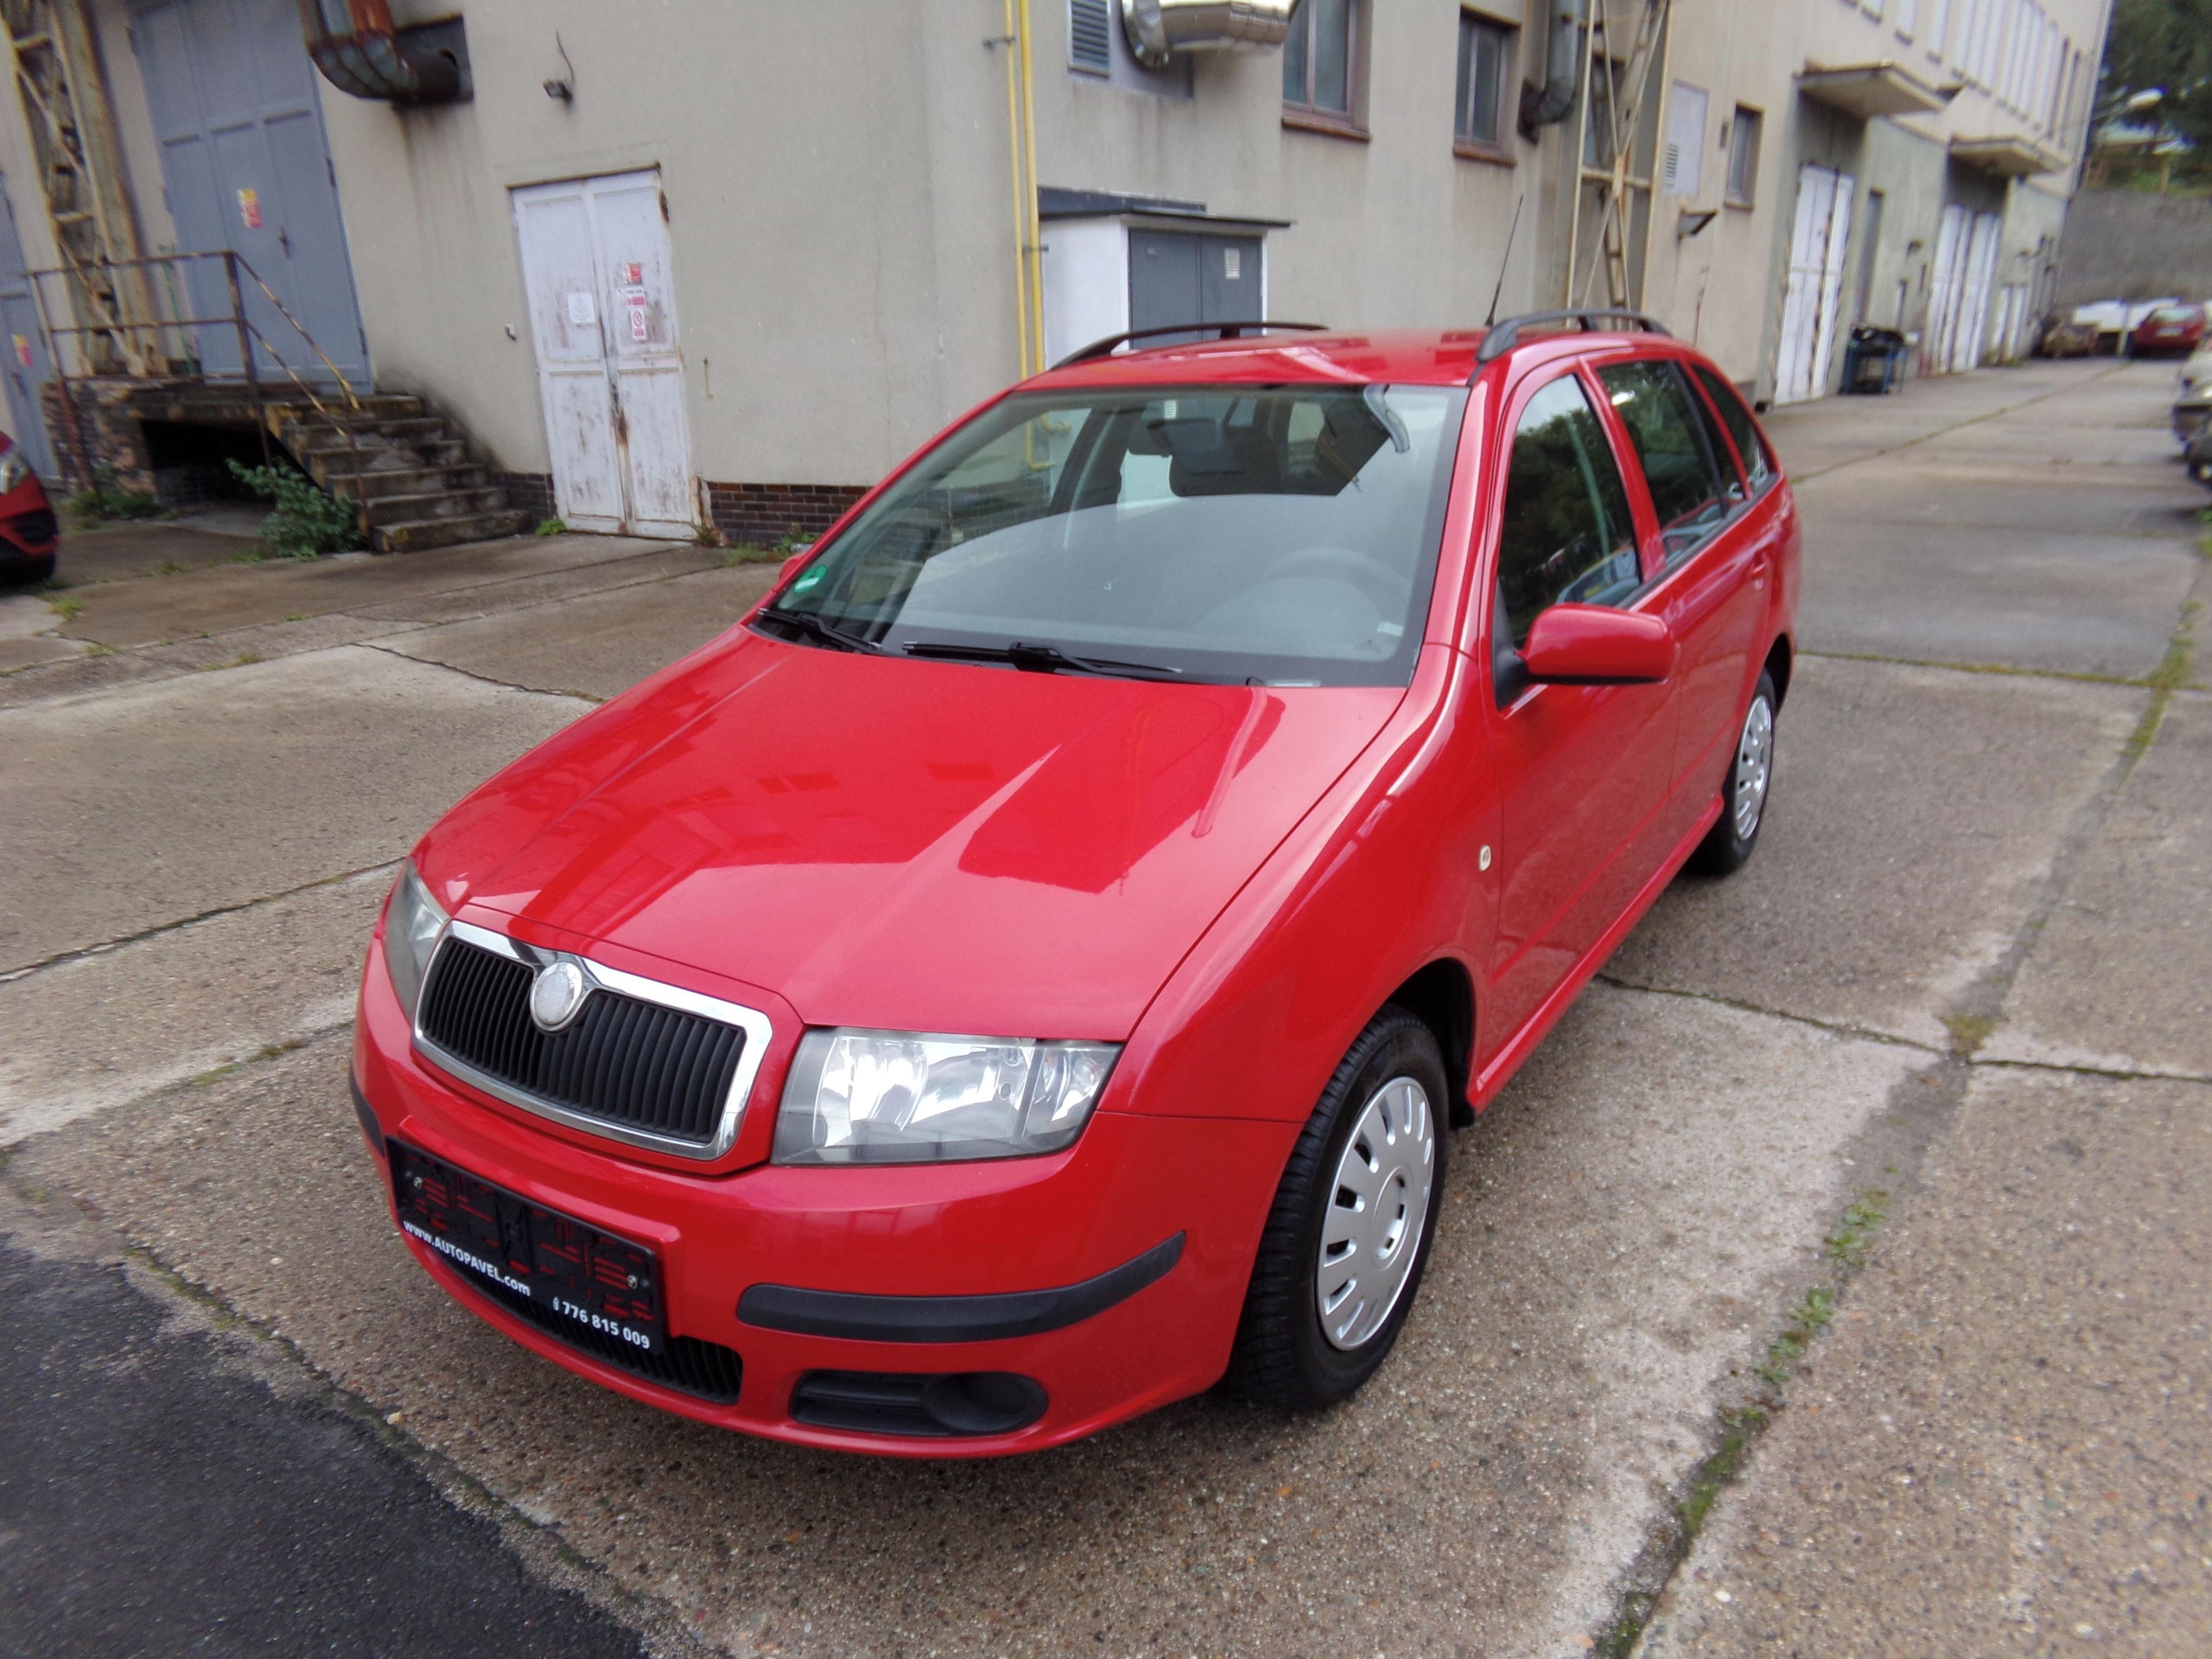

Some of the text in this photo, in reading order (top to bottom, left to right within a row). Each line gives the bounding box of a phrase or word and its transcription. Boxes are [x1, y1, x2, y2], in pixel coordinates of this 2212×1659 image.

[403, 1220, 531, 1296] www.AUTOPAVEL.com
[562, 1301, 650, 1348] 776 815 009
